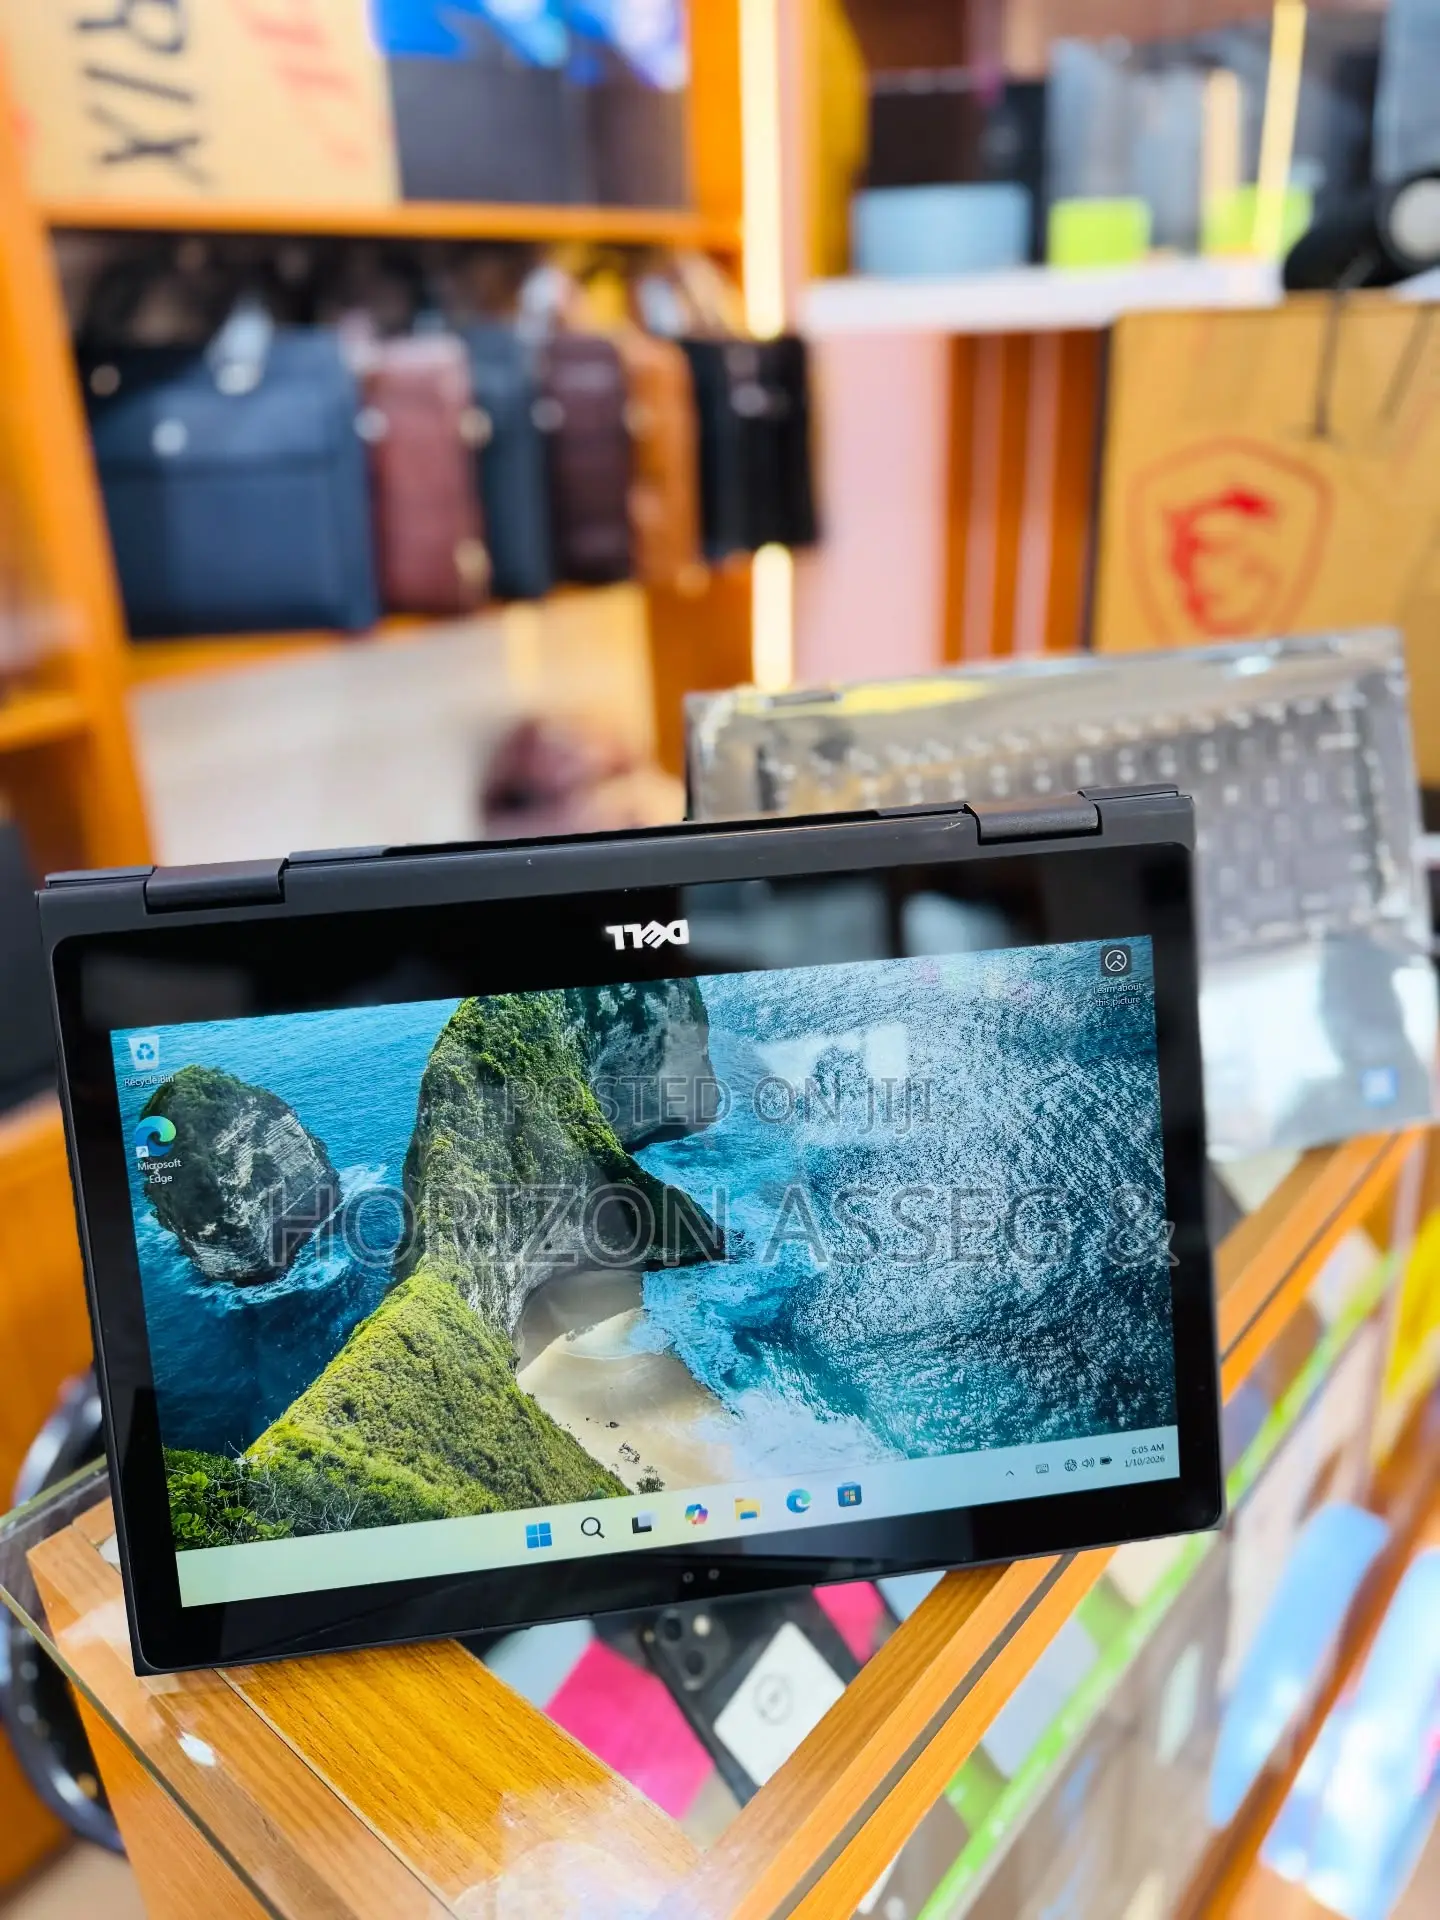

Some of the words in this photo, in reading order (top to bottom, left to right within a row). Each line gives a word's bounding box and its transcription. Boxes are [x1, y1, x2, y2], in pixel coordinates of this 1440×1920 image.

[605, 920, 690, 950] DELL
[1118, 984, 1142, 992] about
[124, 1075, 157, 1089] Recycle
[160, 1075, 174, 1085] Bin
[137, 1159, 182, 1171] Microsoft
[150, 1174, 173, 1185] Edge
[1131, 1446, 1149, 1455] 6:05
[1151, 1443, 1165, 1452] AM
[1125, 1455, 1166, 1468] 1/10/2026
